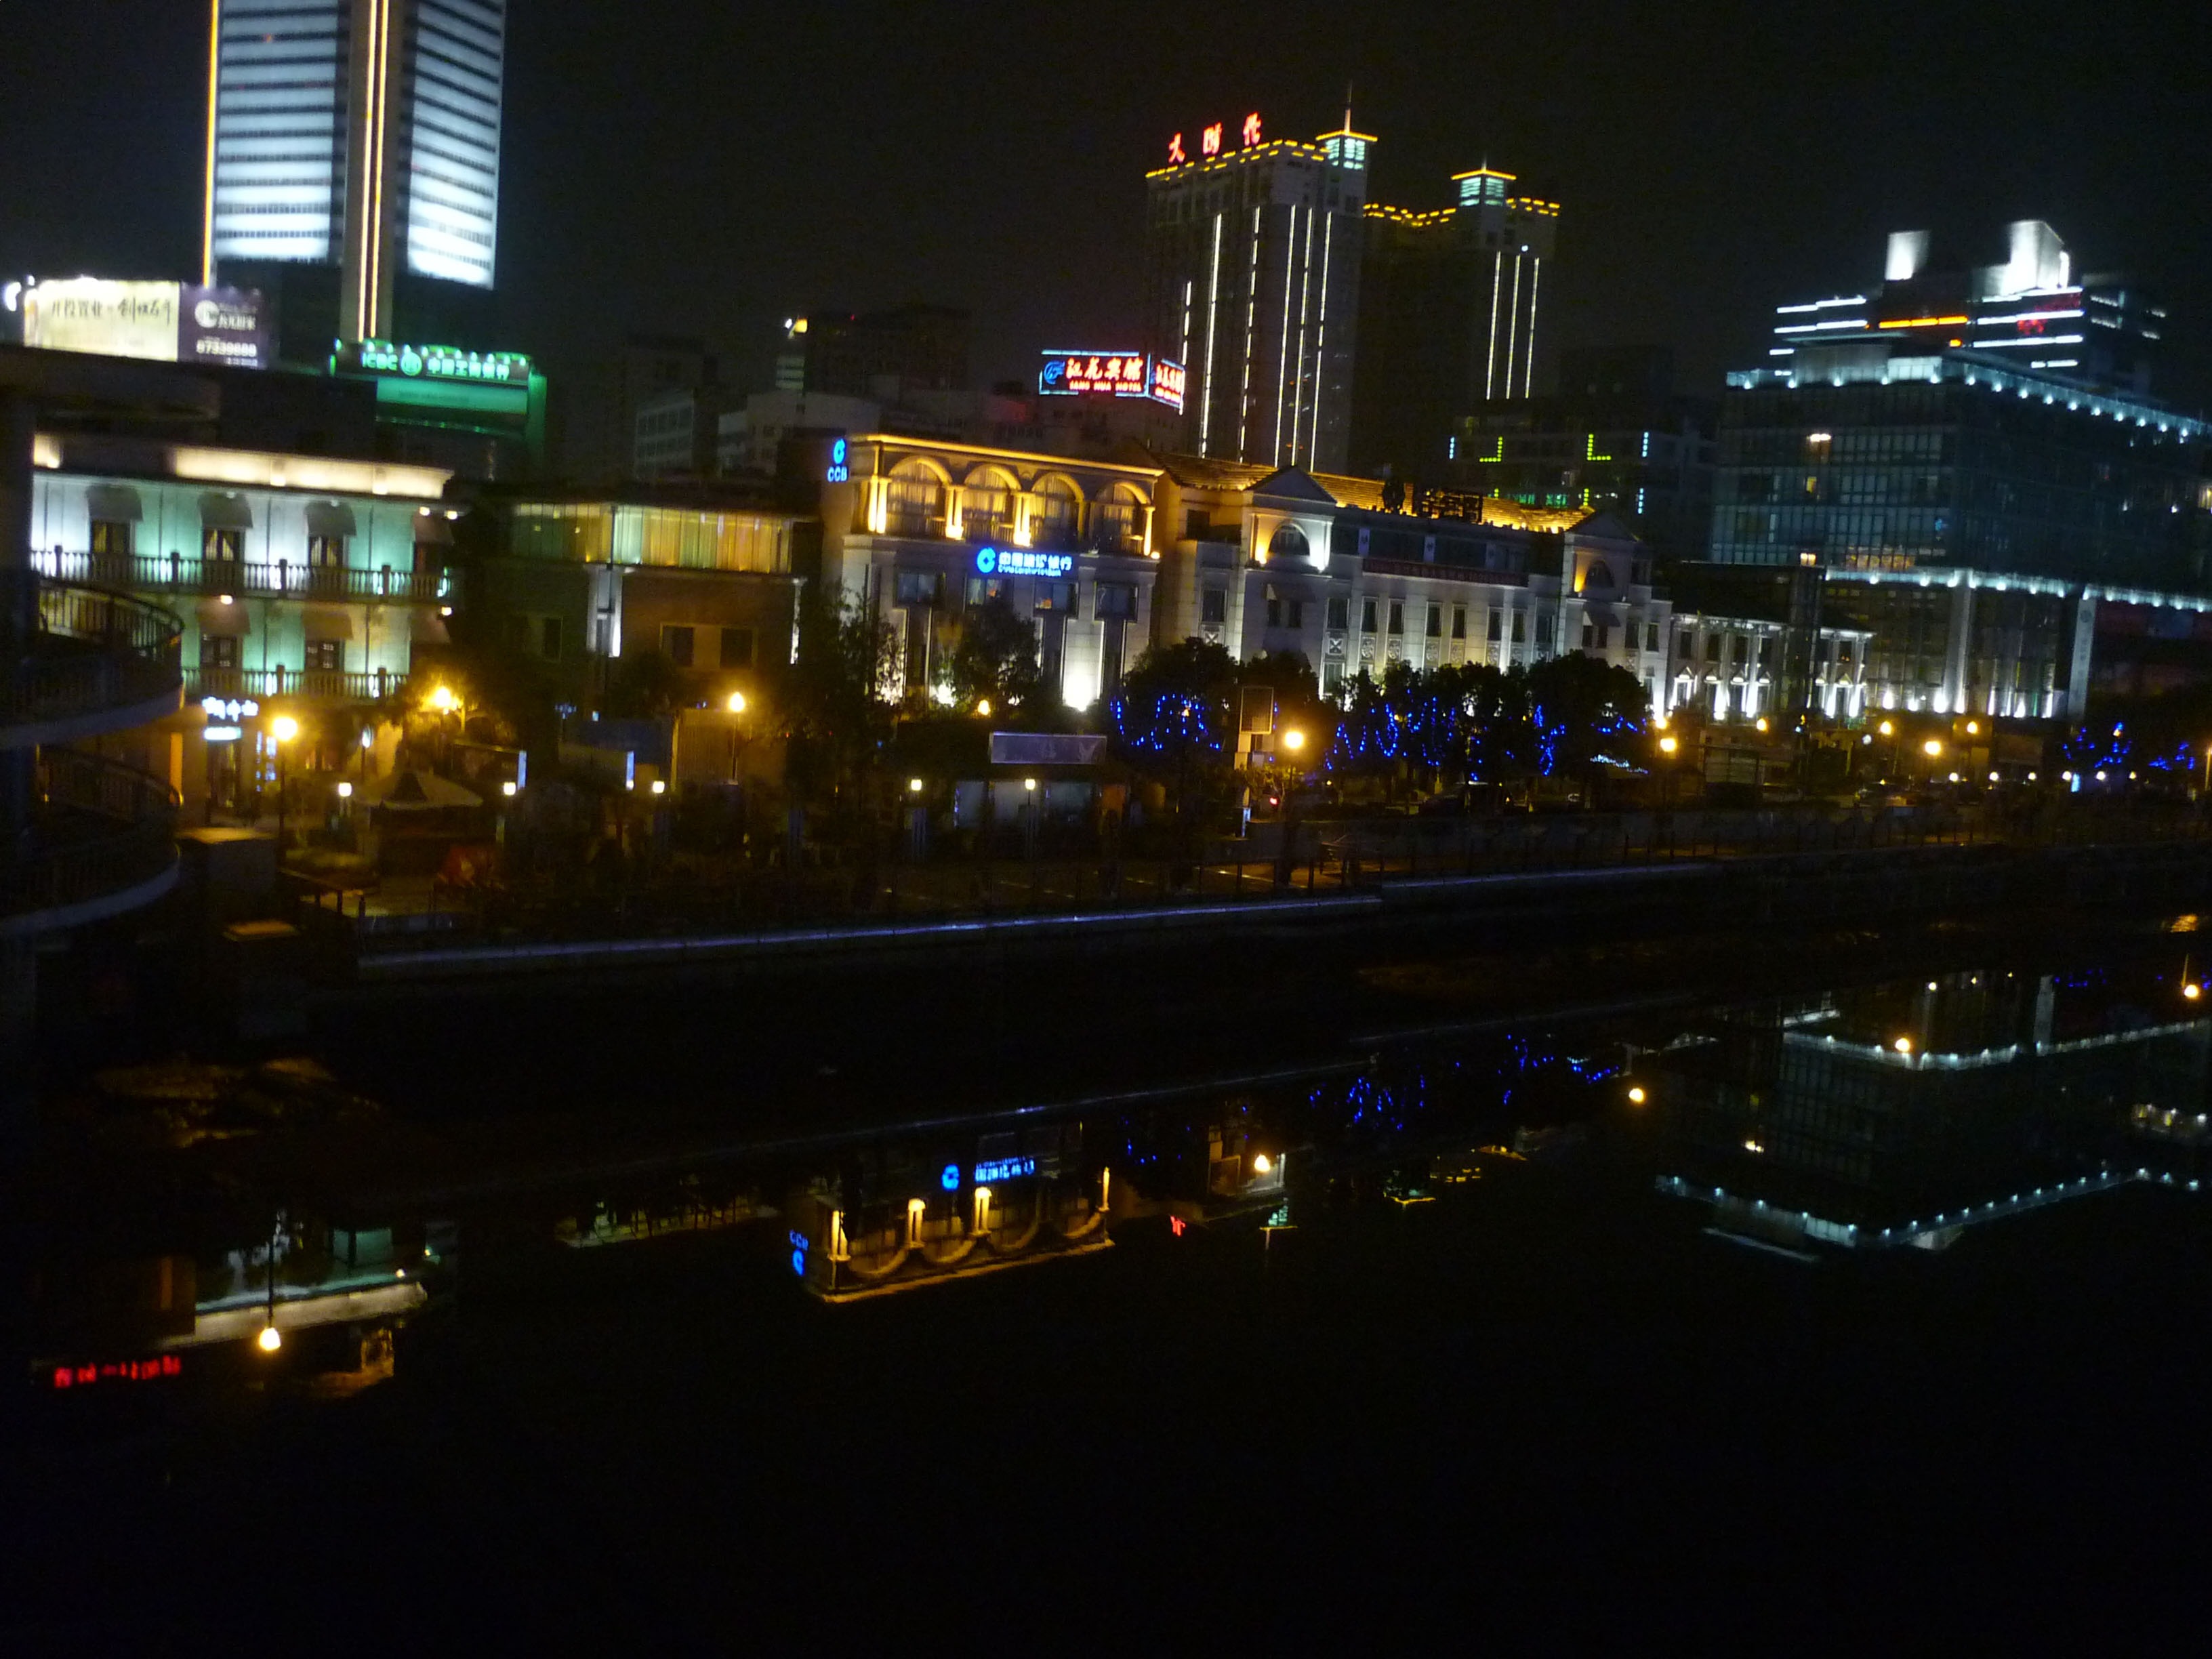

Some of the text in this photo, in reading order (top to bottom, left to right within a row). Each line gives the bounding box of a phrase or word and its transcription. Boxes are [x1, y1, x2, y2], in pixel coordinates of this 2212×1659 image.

[1168, 112, 1262, 163] 大时代
[827, 466, 848, 483] CCB
[998, 551, 1072, 571] 中国建设银行
